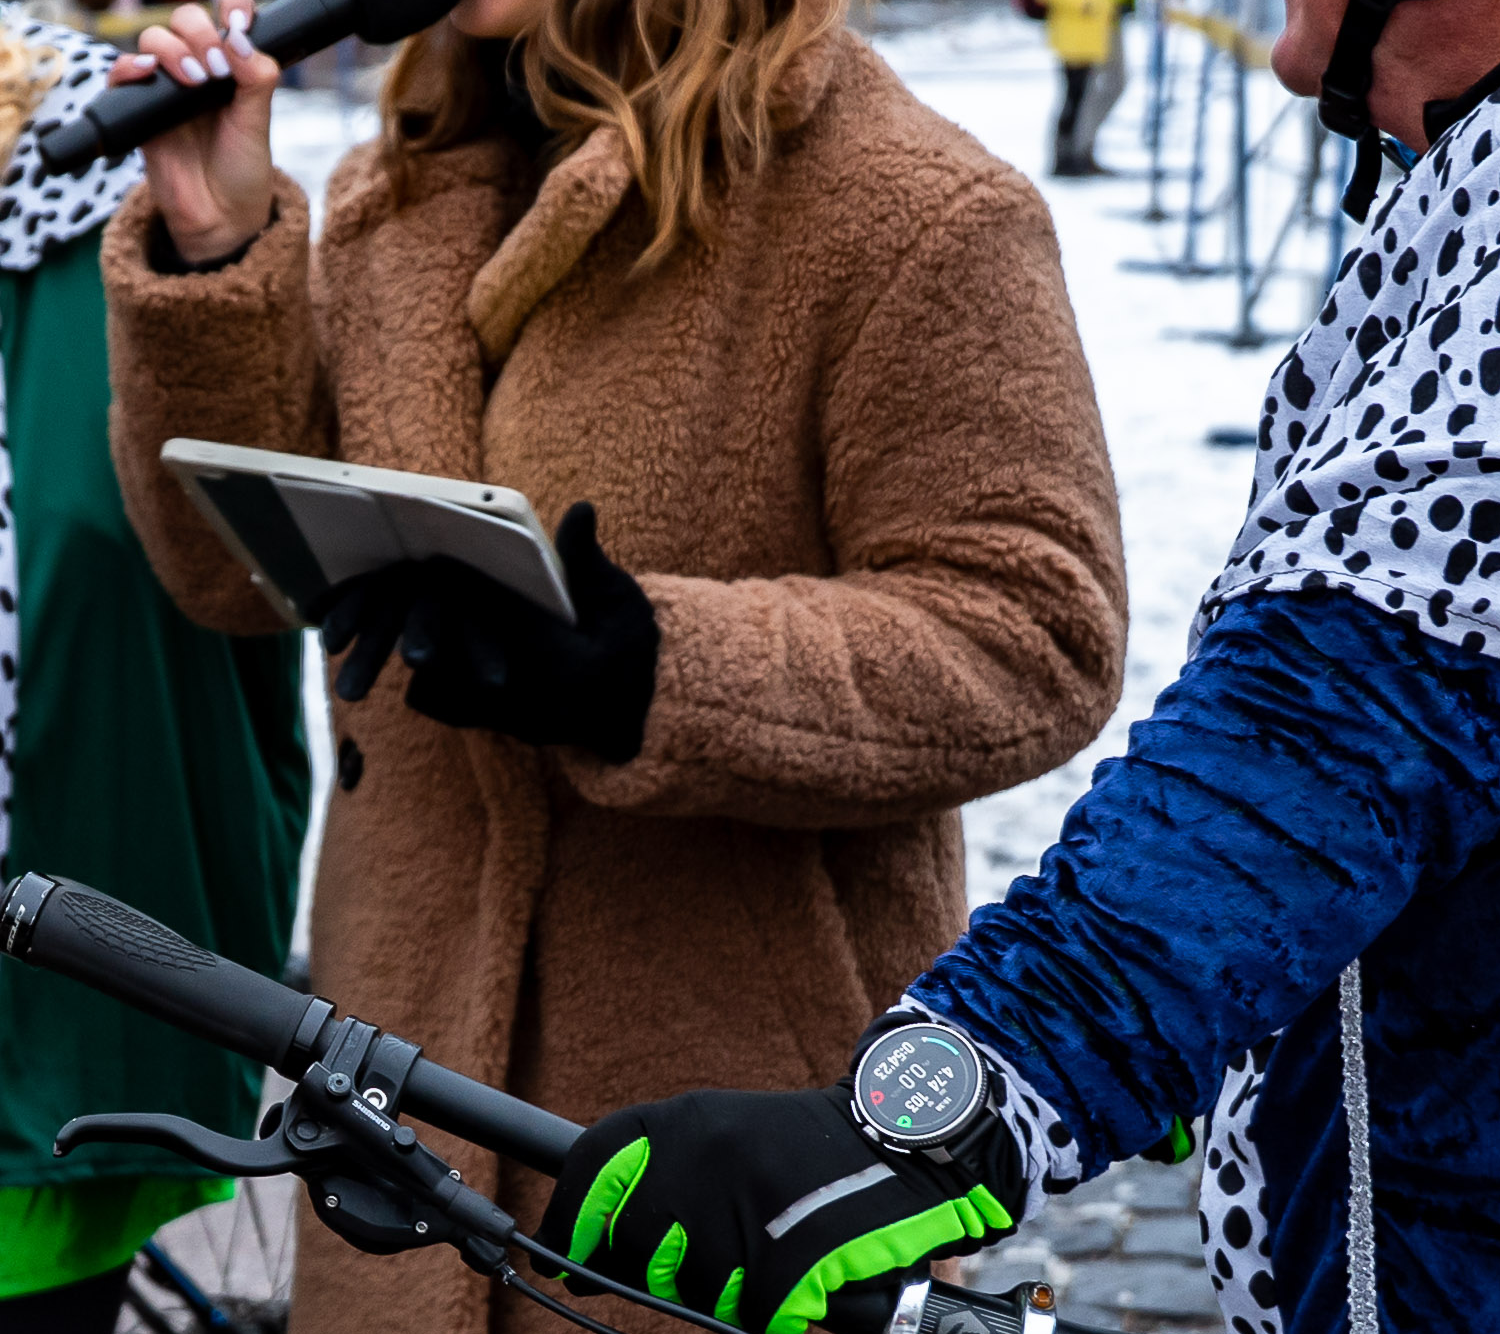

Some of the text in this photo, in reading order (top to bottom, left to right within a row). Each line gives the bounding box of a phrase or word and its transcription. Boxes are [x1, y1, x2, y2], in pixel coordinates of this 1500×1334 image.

[873, 1041, 916, 1081] 0:54'23
[898, 1063, 927, 1090] 0.0
[926, 1066, 955, 1093] 4.74
[351, 1097, 392, 1133] SHIMANO
[904, 1091, 930, 1114] 103
